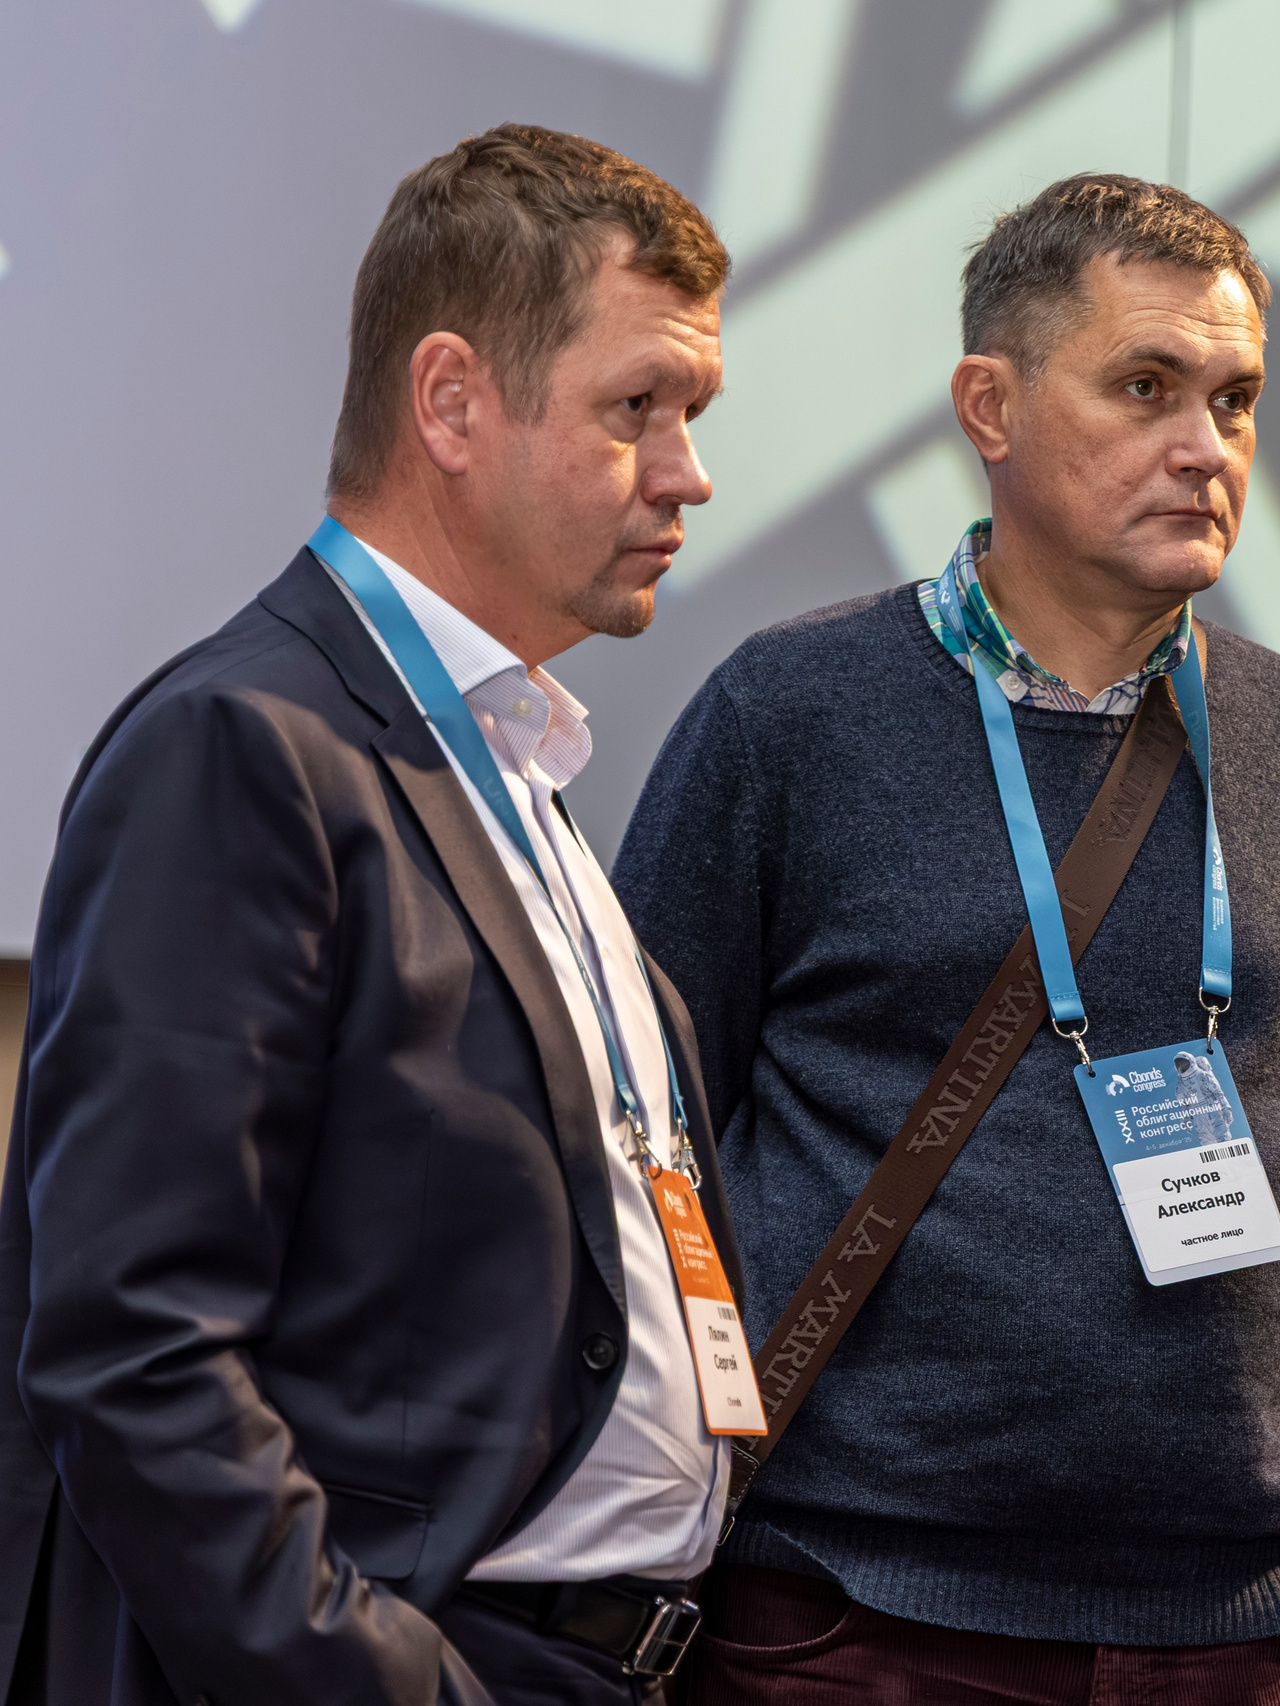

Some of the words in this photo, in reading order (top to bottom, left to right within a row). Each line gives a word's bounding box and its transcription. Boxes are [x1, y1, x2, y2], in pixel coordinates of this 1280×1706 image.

[1128, 1067, 1163, 1085] Cbonds
[1132, 1079, 1167, 1093] congress
[1131, 1093, 1199, 1116] Российский
[1136, 1100, 1222, 1128] облигационный
[1114, 1109, 1135, 1145] XXIII
[1140, 1120, 1194, 1139] конгресс
[1161, 1171, 1221, 1193] Сучков
[1158, 1191, 1245, 1219] Александр
[838, 1204, 898, 1262] LA
[1181, 1232, 1219, 1246] частное
[1221, 1228, 1244, 1239] лицо
[708, 1325, 730, 1342] Лялин
[714, 1354, 738, 1374] Сергей
